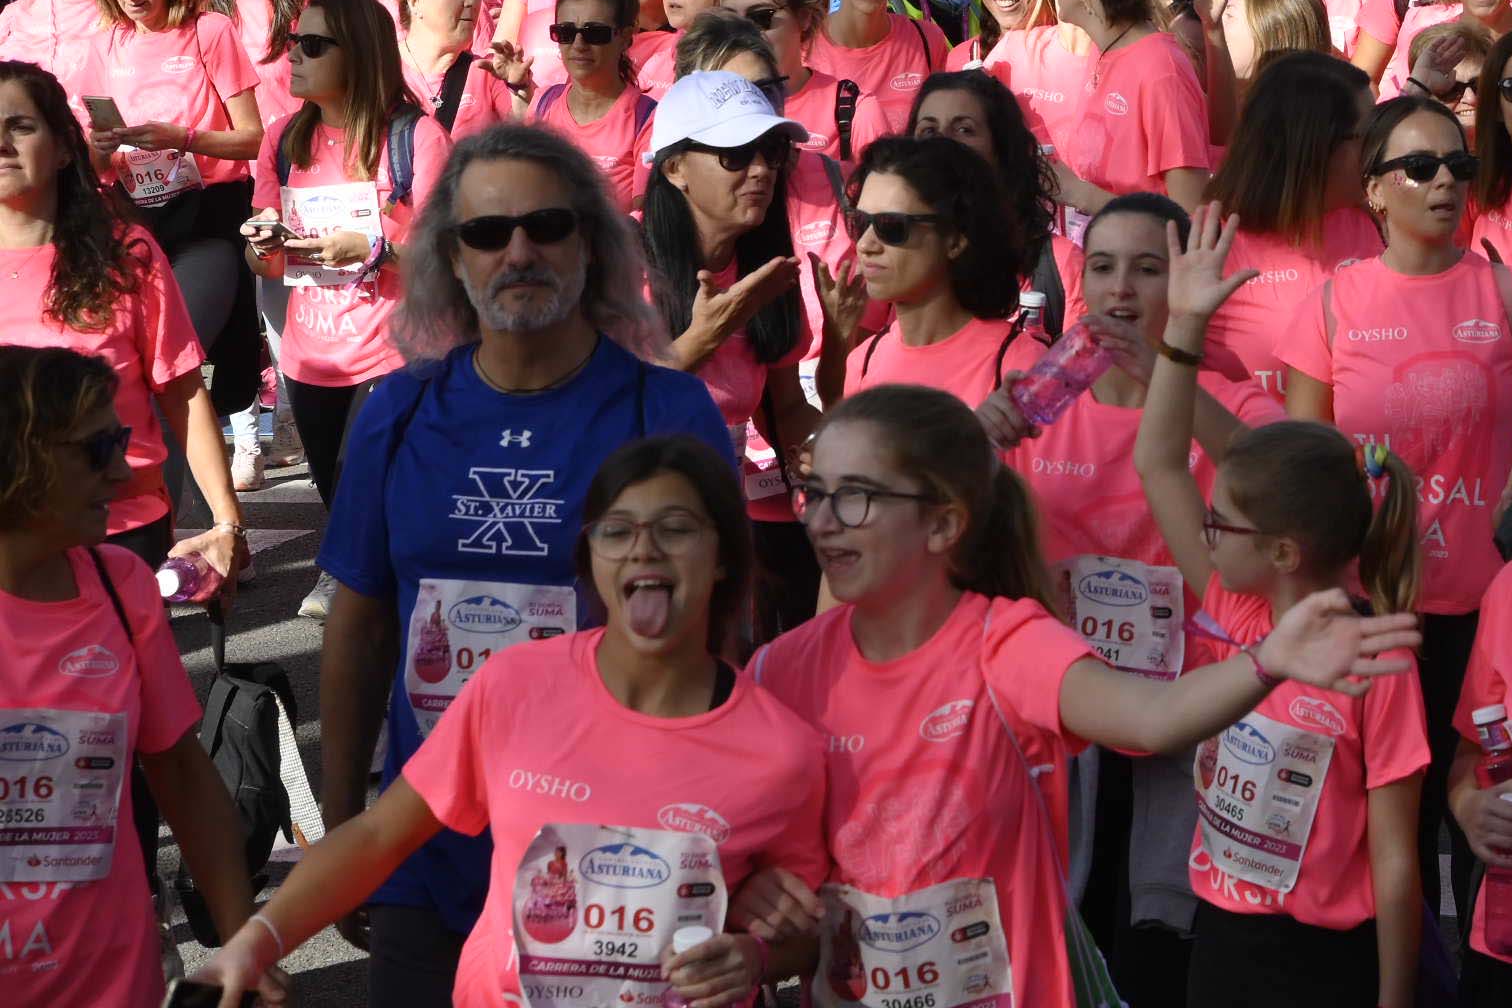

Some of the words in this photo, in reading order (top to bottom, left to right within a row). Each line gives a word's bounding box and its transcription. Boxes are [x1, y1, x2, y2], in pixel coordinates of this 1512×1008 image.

[1348, 327, 1408, 342] OYSHO
[1032, 456, 1096, 479] OYSHO
[455, 498, 483, 517] ST.
[490, 501, 558, 519] XAVIER
[1083, 580, 1144, 602] ASTURIANA
[528, 607, 564, 617] SUMA
[1081, 616, 1135, 642] 016
[1223, 727, 1269, 762] ASTURIANA
[1283, 749, 1317, 764] SUMA
[508, 768, 591, 802] OYSHO
[1217, 765, 1257, 802] 016
[16, 832, 30, 842] LA
[31, 832, 71, 841] MUJER
[43, 855, 103, 868] Santander
[585, 860, 662, 881] ASTURIANA
[1232, 851, 1285, 878] Santander
[584, 903, 655, 934] 016
[862, 923, 935, 943] ASTURIANA
[946, 897, 984, 915] SUMA
[593, 940, 638, 959] 3942
[589, 964, 606, 974] DE
[608, 965, 625, 976] LA
[870, 960, 940, 991] 016
